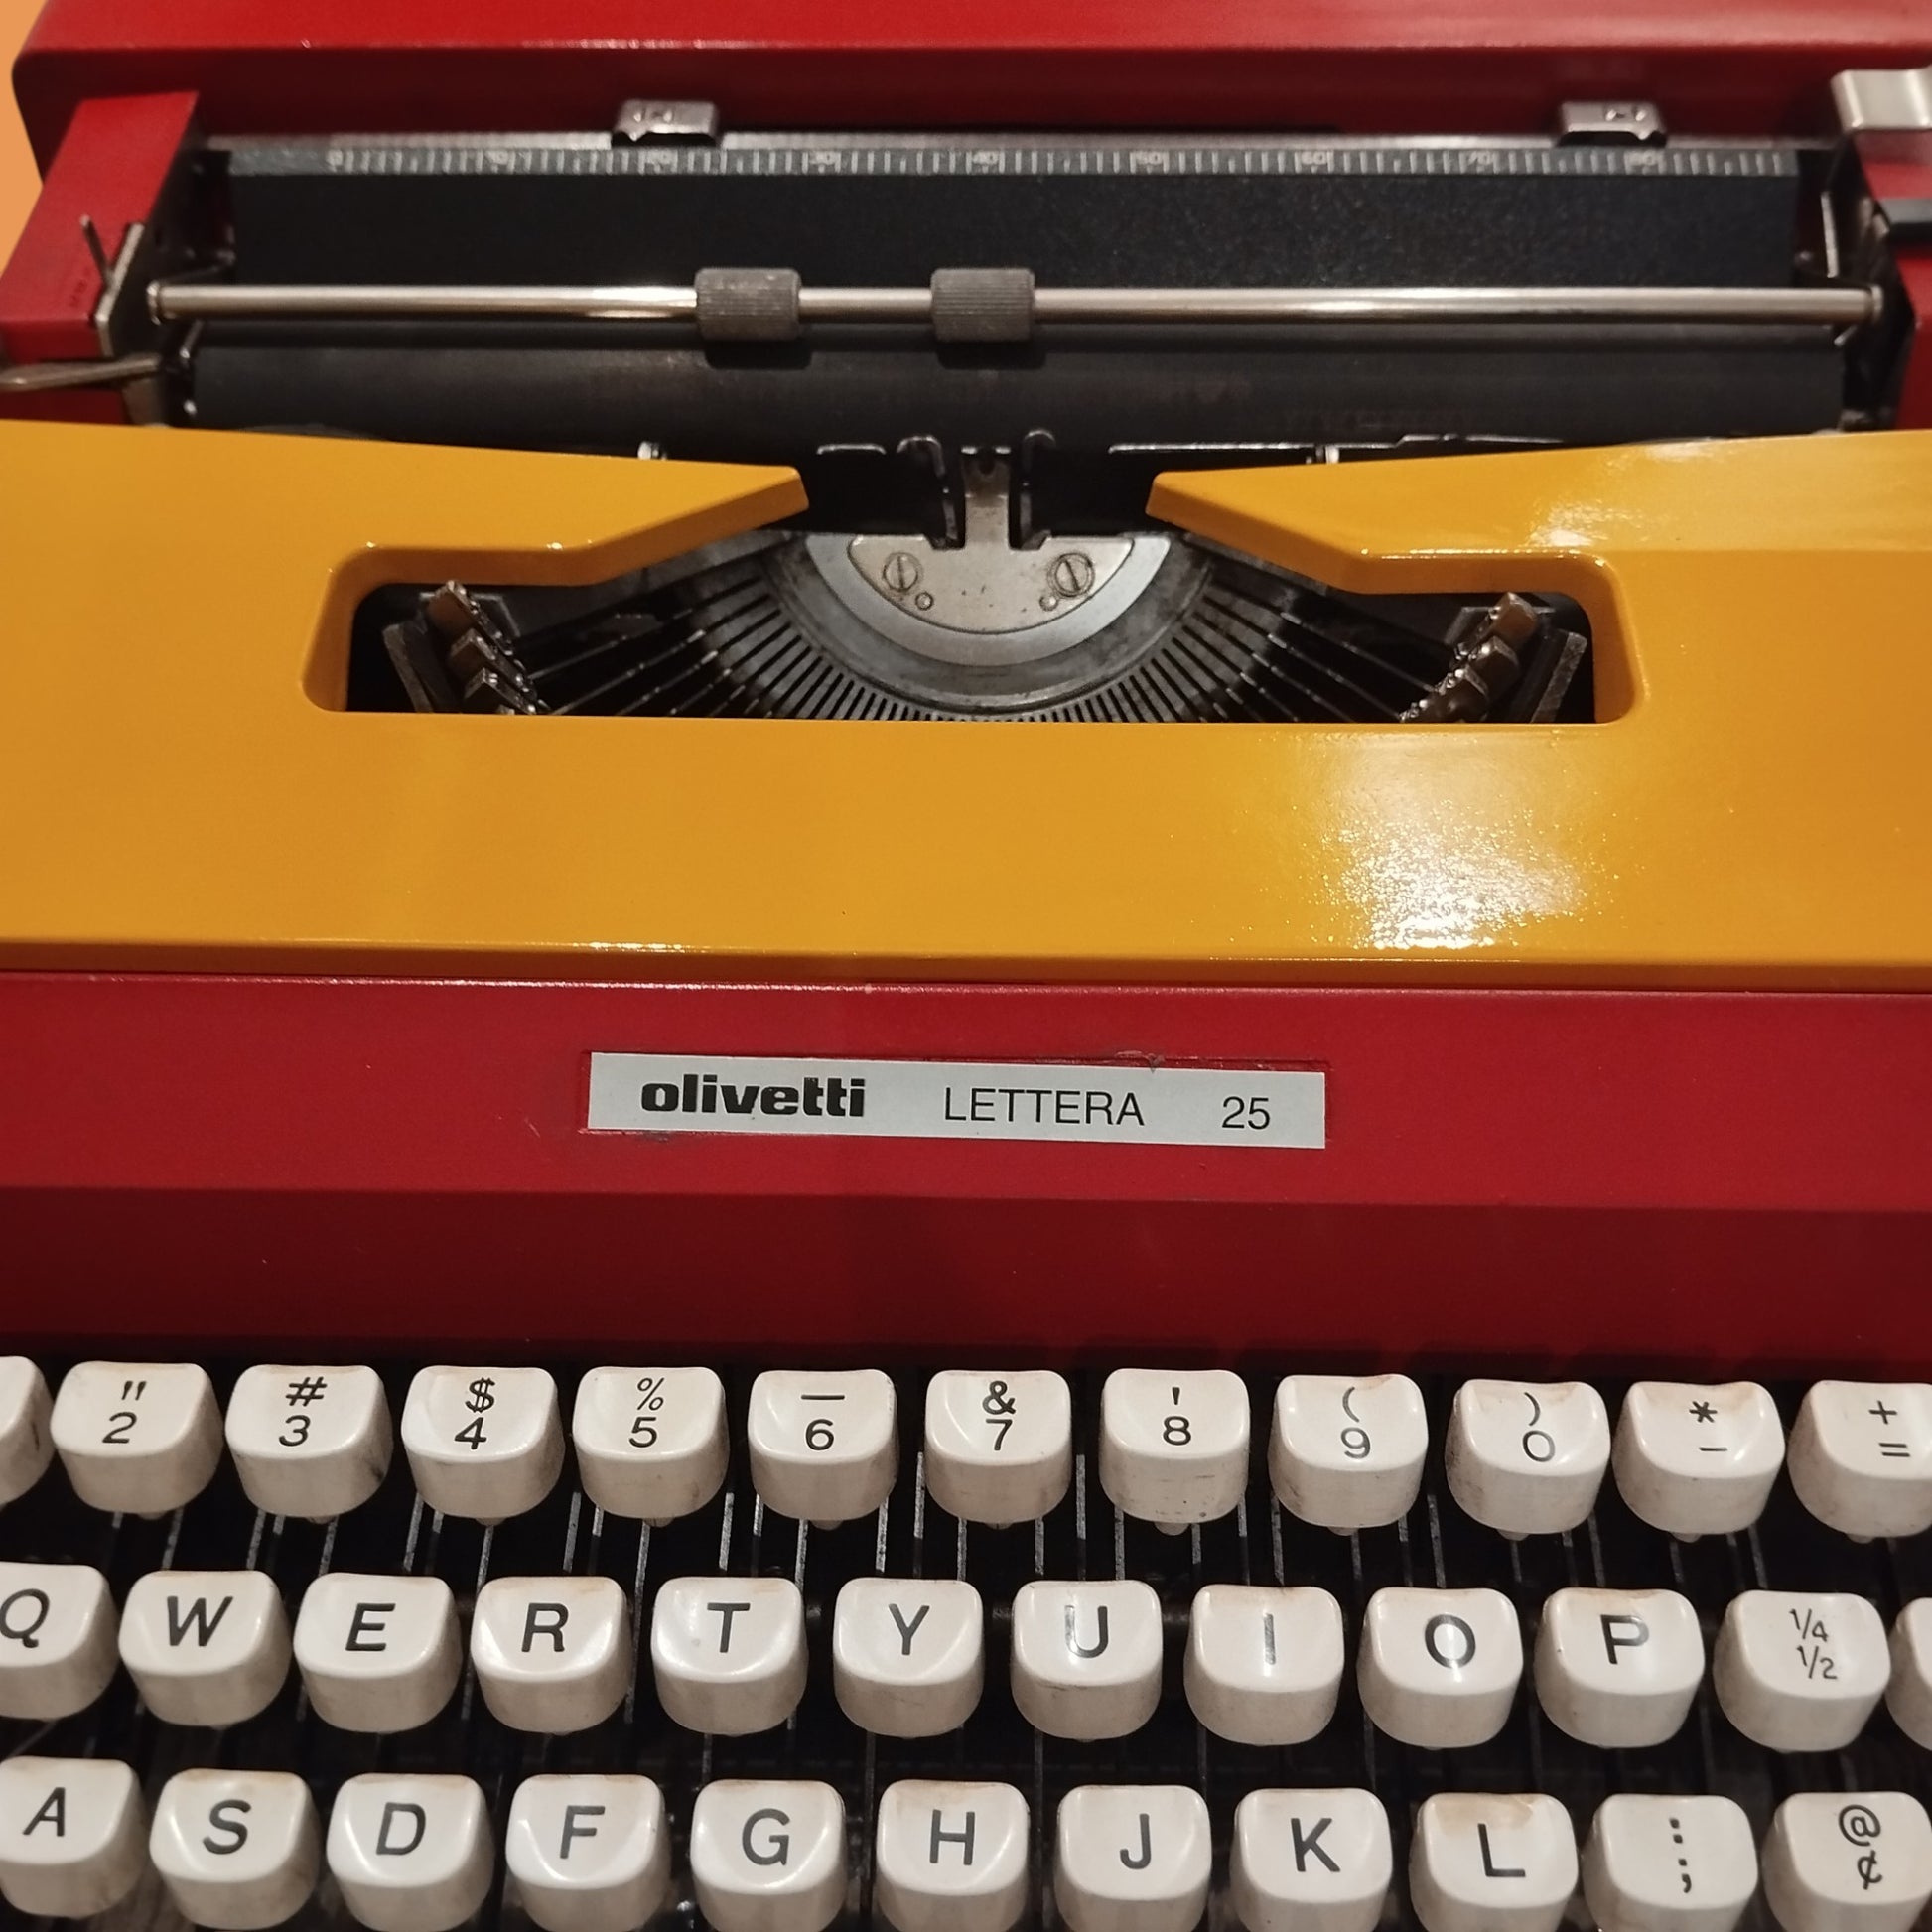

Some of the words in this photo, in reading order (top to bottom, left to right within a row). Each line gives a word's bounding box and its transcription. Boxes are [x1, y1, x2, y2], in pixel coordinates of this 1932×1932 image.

[640, 1073, 866, 1118] olivetti
[944, 1087, 1145, 1126] LETTERA
[1221, 1096, 1271, 1130] 25
[285, 1376, 328, 1407] #
[465, 1377, 496, 1414] $
[636, 1377, 665, 1411] %
[982, 1380, 1017, 1416] &
[1868, 1400, 1897, 1425] +
[101, 1411, 137, 1445] 2
[278, 1414, 311, 1448] 3
[454, 1416, 487, 1450] 4
[628, 1416, 658, 1449] 5
[805, 1418, 835, 1451] 6
[985, 1418, 1013, 1451] 7
[1163, 1415, 1192, 1447] 8
[1340, 1427, 1371, 1459] 9
[1522, 1430, 1556, 1462] 0
[0, 1588, 50, 1649] Q
[167, 1595, 233, 1647] W
[345, 1602, 396, 1652] E
[521, 1602, 569, 1653] R
[707, 1602, 751, 1654] T
[888, 1603, 930, 1656] Y
[1065, 1603, 1109, 1659] U
[1264, 1611, 1277, 1665] I
[1424, 1614, 1476, 1668] O
[1599, 1614, 1651, 1665] P
[23, 1787, 66, 1838] A
[203, 1799, 252, 1856] S
[376, 1802, 427, 1856] D
[559, 1805, 606, 1860] F
[742, 1808, 790, 1866] G
[929, 1808, 976, 1866] H
[1838, 1804, 1881, 1847] @
[1119, 1813, 1152, 1870] J
[1290, 1817, 1341, 1873] K
[1477, 1823, 1526, 1878] L
